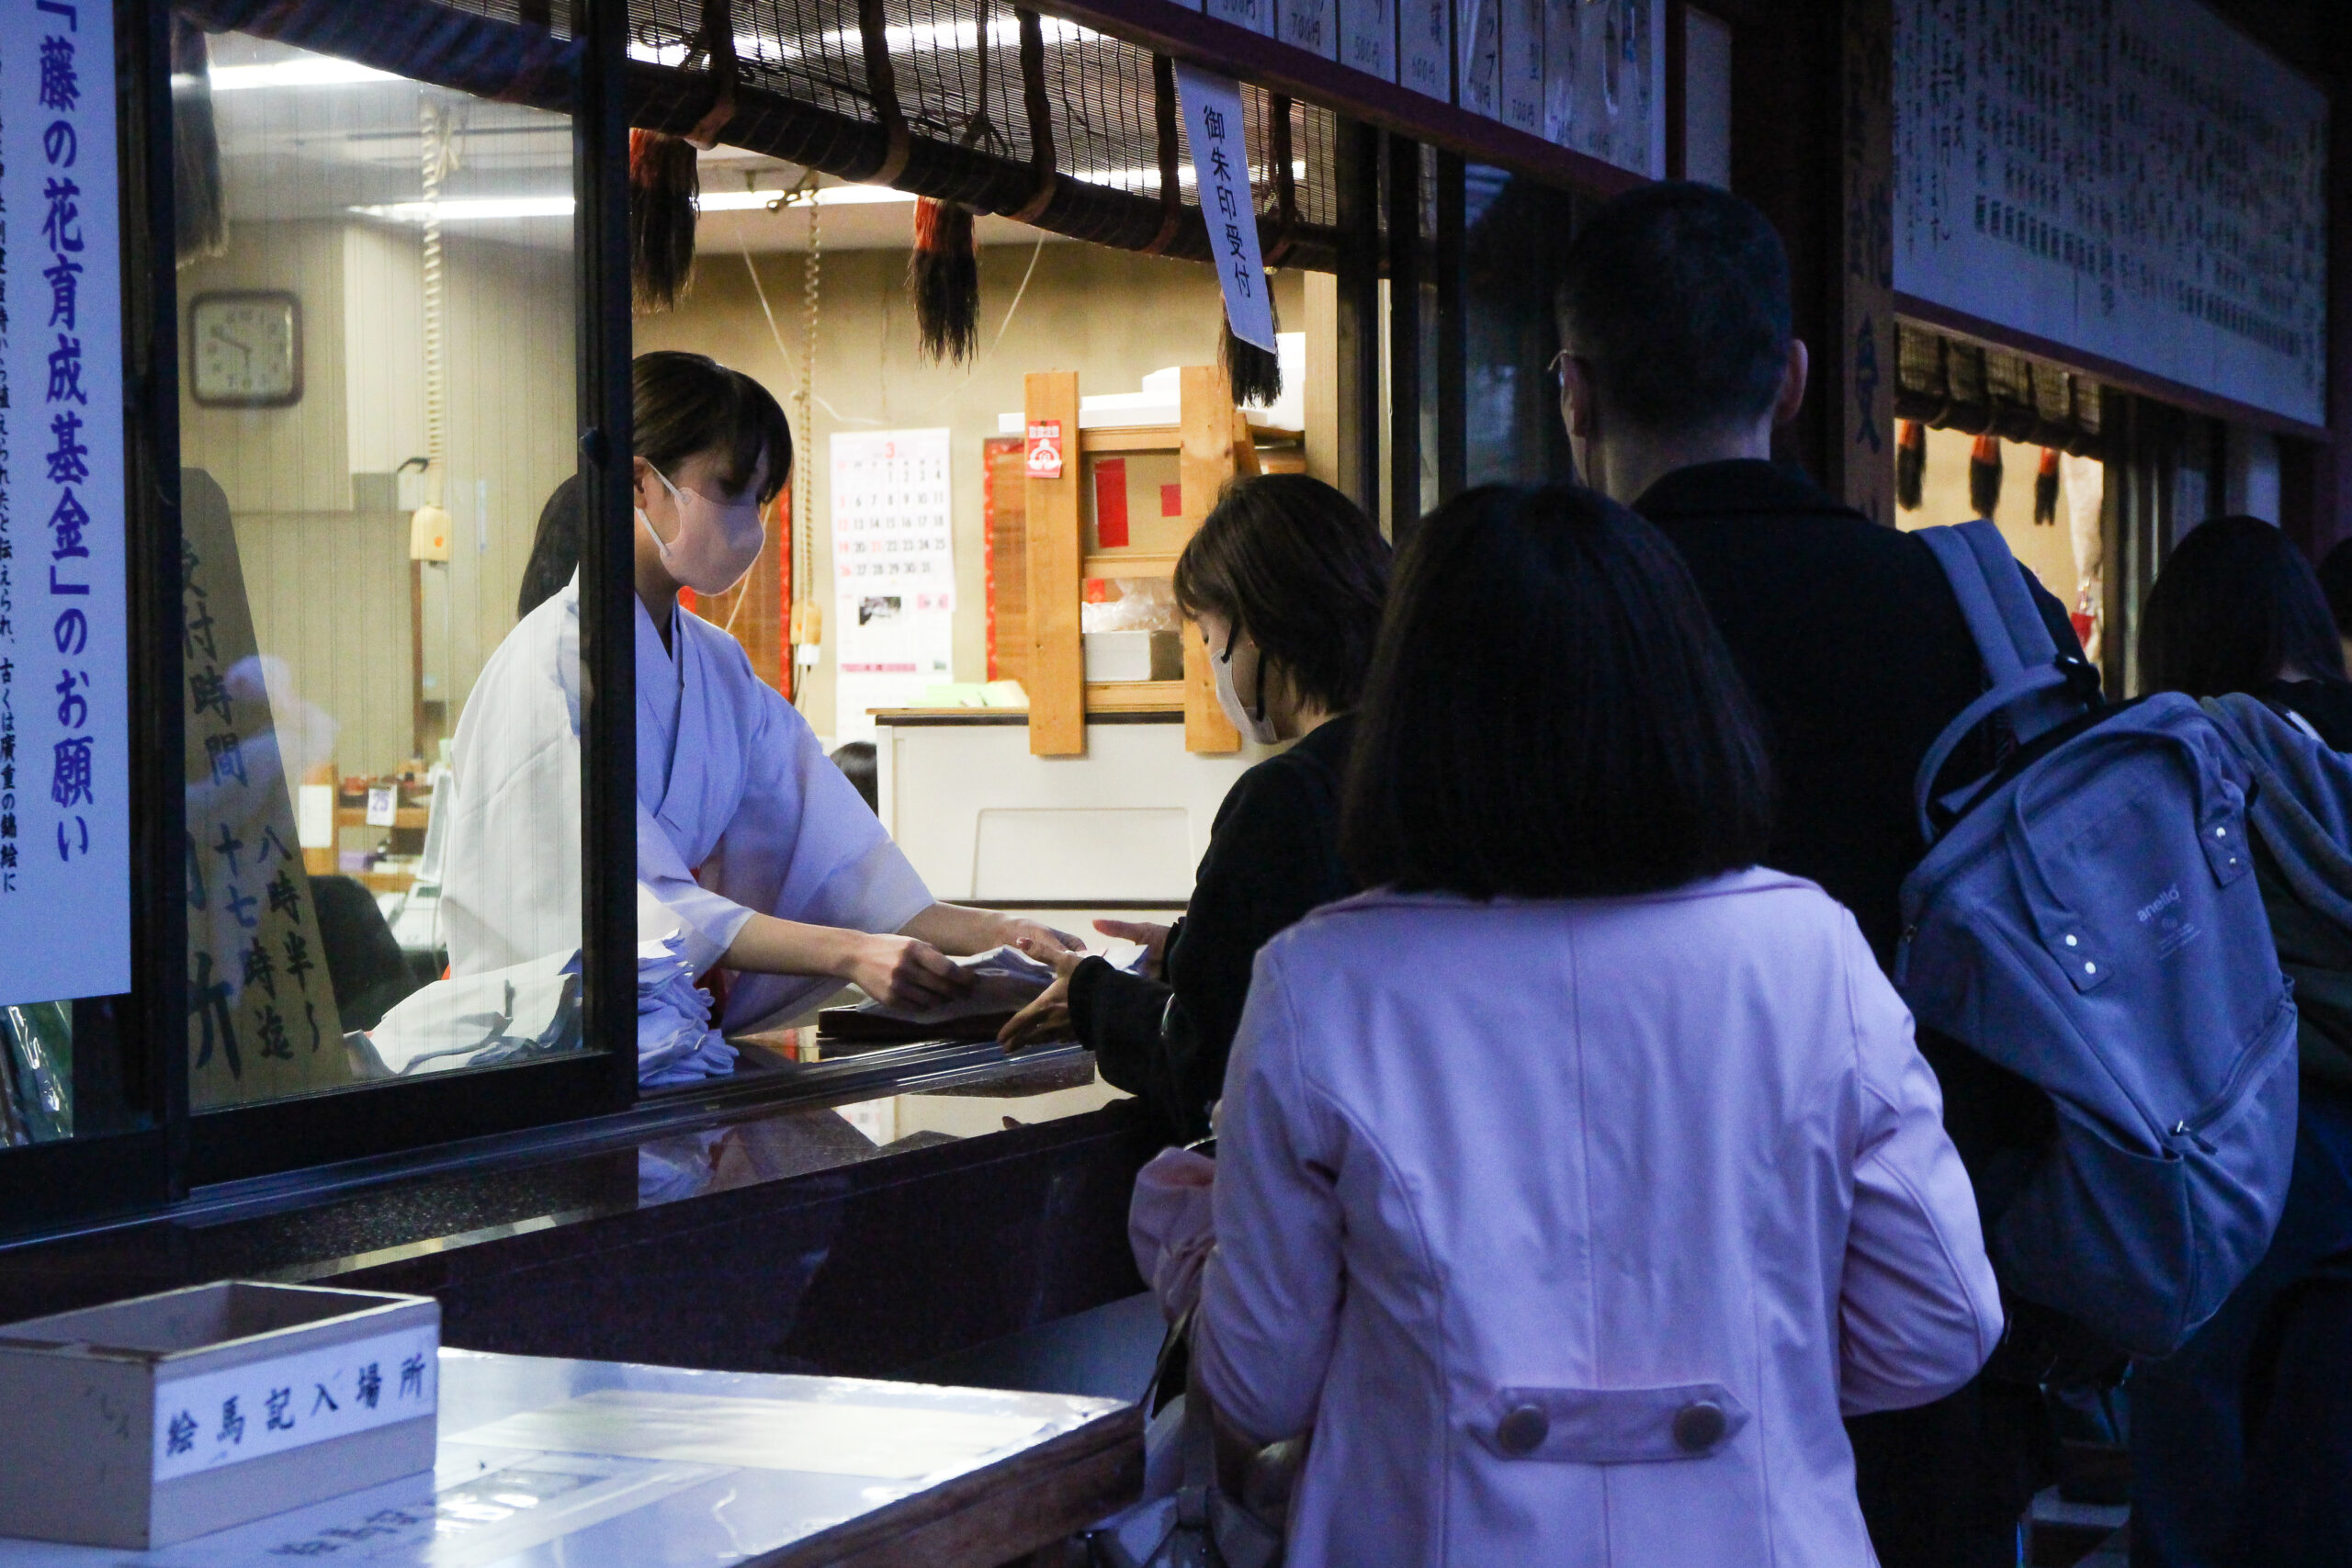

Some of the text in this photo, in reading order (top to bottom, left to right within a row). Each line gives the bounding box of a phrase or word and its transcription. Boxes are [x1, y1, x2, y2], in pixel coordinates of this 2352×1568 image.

[1203, 103, 1252, 299] 御朱印受付
[35, 0, 94, 862] 「藤の花育成基金」のお願い
[884, 441, 896, 458] 3
[2136, 885, 2181, 922] anello
[165, 1350, 427, 1458] 絵馬記入場所
